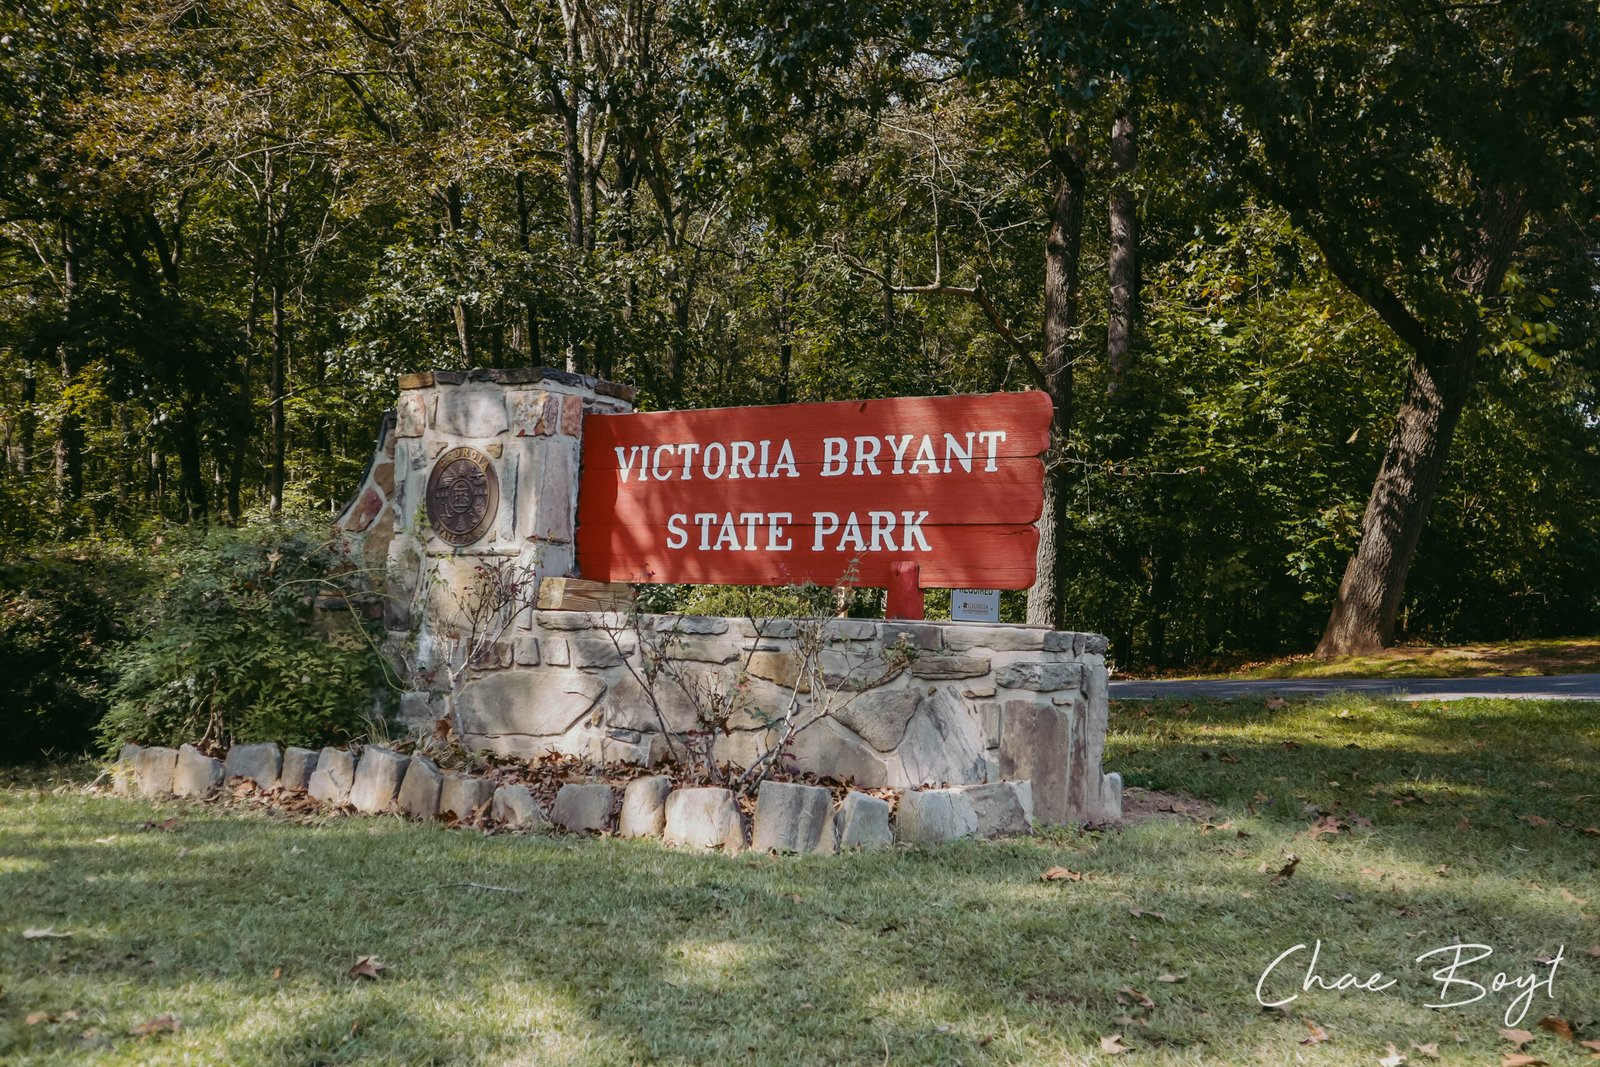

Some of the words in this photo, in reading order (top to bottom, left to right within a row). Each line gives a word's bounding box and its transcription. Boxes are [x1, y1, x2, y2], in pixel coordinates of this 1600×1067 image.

[614, 438, 800, 484] VICTORIA
[820, 430, 1007, 477] BRYANT
[666, 512, 792, 551] STATE
[811, 510, 933, 552] PARK
